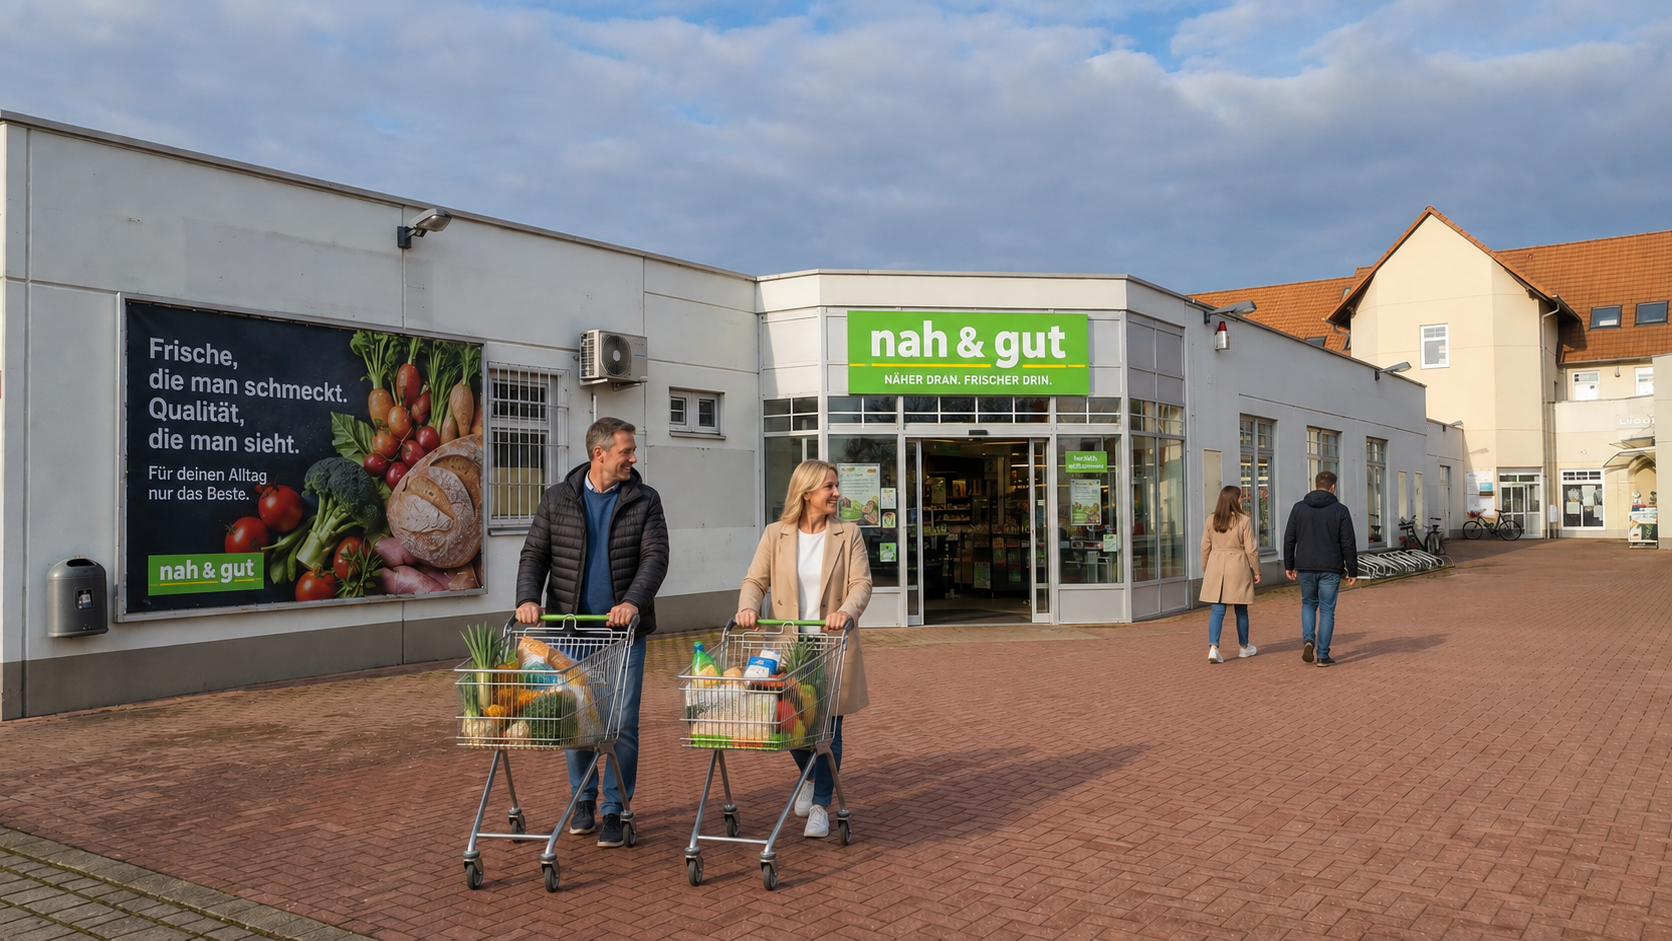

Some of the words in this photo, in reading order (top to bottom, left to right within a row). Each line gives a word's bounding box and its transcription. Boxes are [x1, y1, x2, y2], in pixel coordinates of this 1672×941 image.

[150, 337, 238, 370] Frische,
[871, 320, 948, 357] nah
[957, 326, 985, 358] &
[995, 326, 1067, 368] gut
[149, 368, 184, 391] die
[191, 376, 238, 395] man
[244, 377, 348, 403] schmeckt.
[884, 372, 923, 385] NÄHER
[926, 374, 961, 385] DRAN.
[964, 375, 1019, 386] FRISCHER
[1023, 375, 1052, 386] DRIN.
[149, 397, 245, 427] Qualität,
[149, 427, 184, 450] die
[190, 434, 238, 452] man
[244, 432, 300, 454] sieht.
[148, 465, 174, 480] Für
[177, 466, 225, 481] deinen
[228, 467, 267, 485] Alltag
[148, 488, 174, 500] nur
[177, 485, 203, 500] das
[207, 486, 250, 501] Beste.
[160, 559, 199, 581] nah
[202, 562, 216, 579] &
[220, 559, 255, 584] gut
